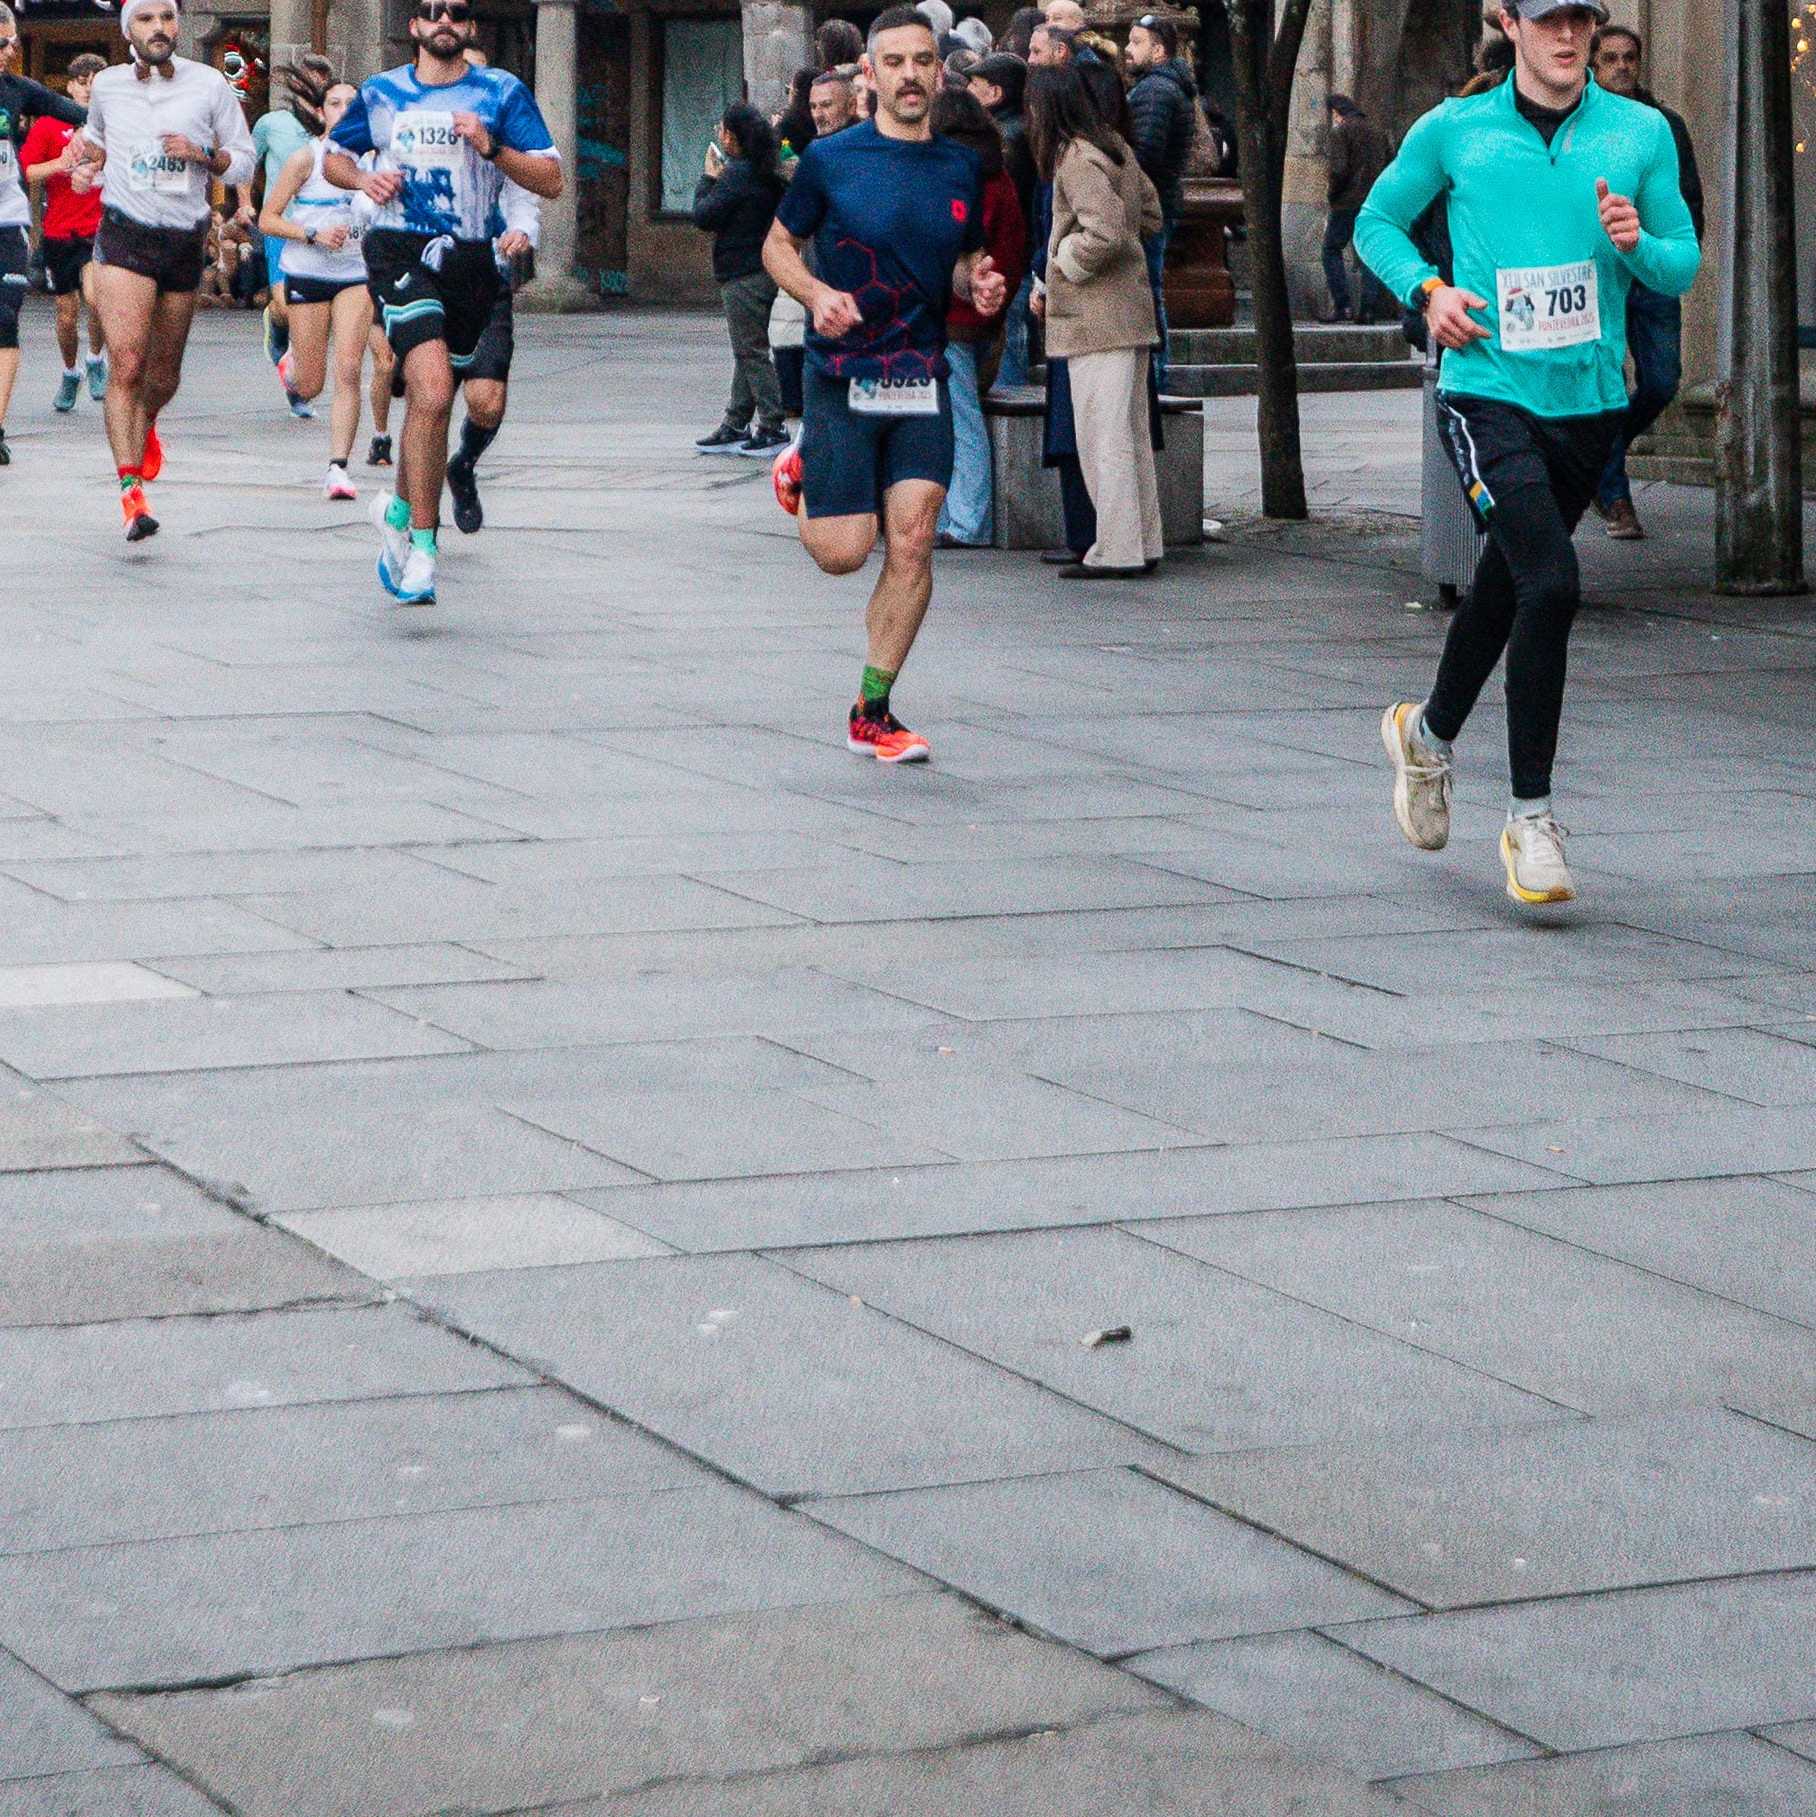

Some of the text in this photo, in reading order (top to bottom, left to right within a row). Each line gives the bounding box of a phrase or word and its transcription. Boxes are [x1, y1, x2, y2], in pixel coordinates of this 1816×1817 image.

[419, 126, 460, 146] 1326
[1524, 270, 1545, 288] SAN
[1548, 263, 1593, 286] SILVESTRE
[1544, 284, 1587, 317] 703
